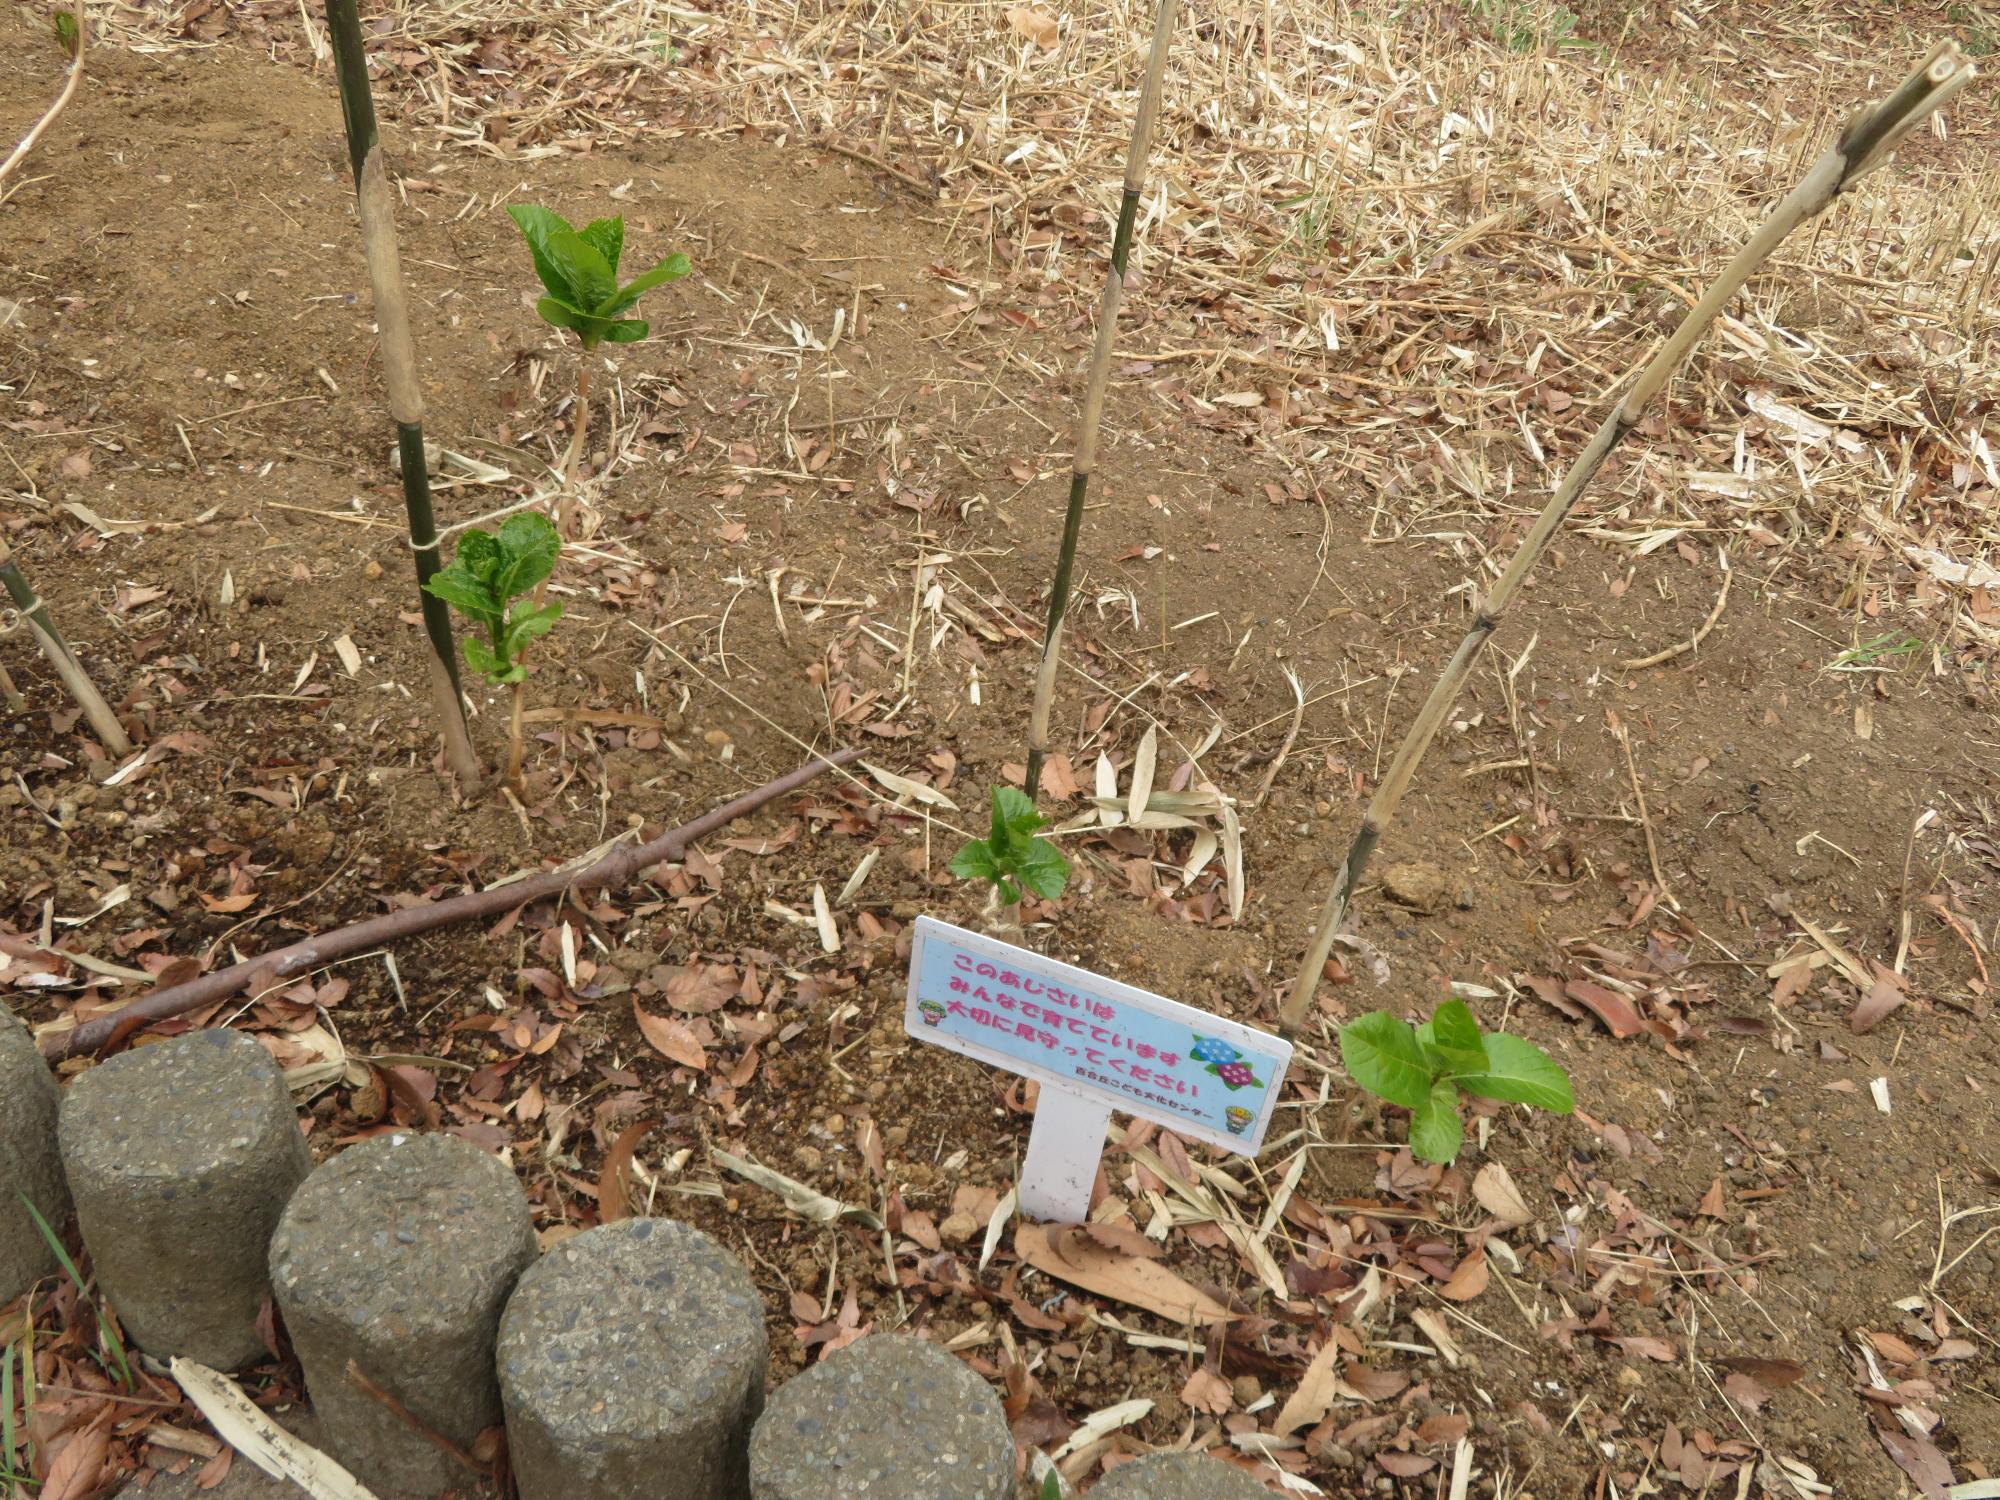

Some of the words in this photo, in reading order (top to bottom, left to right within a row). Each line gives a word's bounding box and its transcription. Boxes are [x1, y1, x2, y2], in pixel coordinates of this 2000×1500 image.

[949, 975, 1181, 1067] みんなで育てています
[953, 953, 1116, 1020] このあじさいは
[946, 1000, 1199, 1098] 大切に見守ってください
[1075, 1066, 1215, 1119] 百合丘こども文化センター
